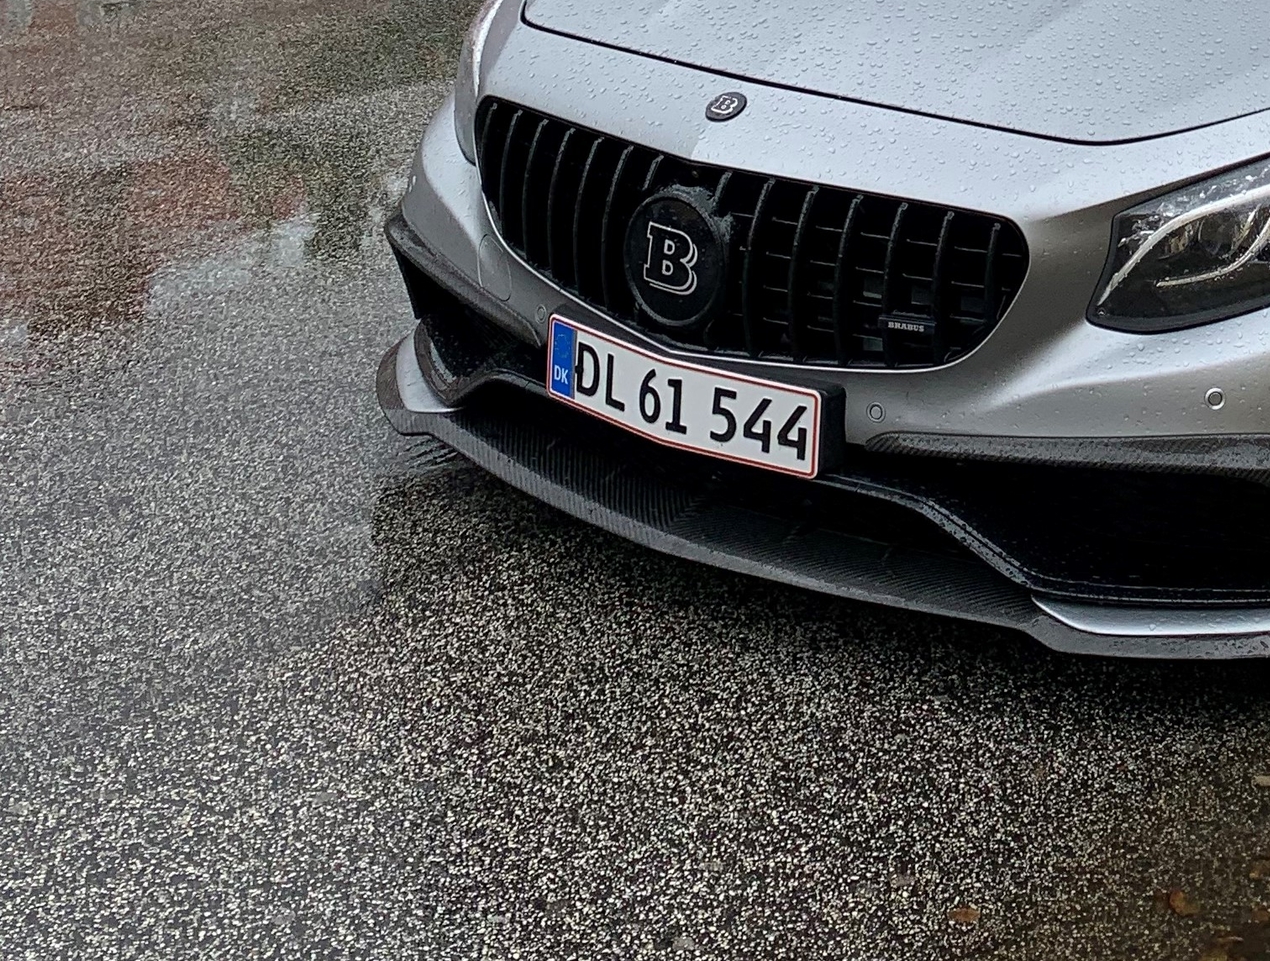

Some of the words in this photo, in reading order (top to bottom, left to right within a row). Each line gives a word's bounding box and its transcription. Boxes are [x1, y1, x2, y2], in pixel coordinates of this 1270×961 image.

[643, 221, 698, 295] B
[888, 321, 925, 332] BRABUS
[554, 364, 569, 385] DK
[575, 341, 625, 412] DL
[639, 368, 687, 435] 61
[710, 386, 808, 461] 544
